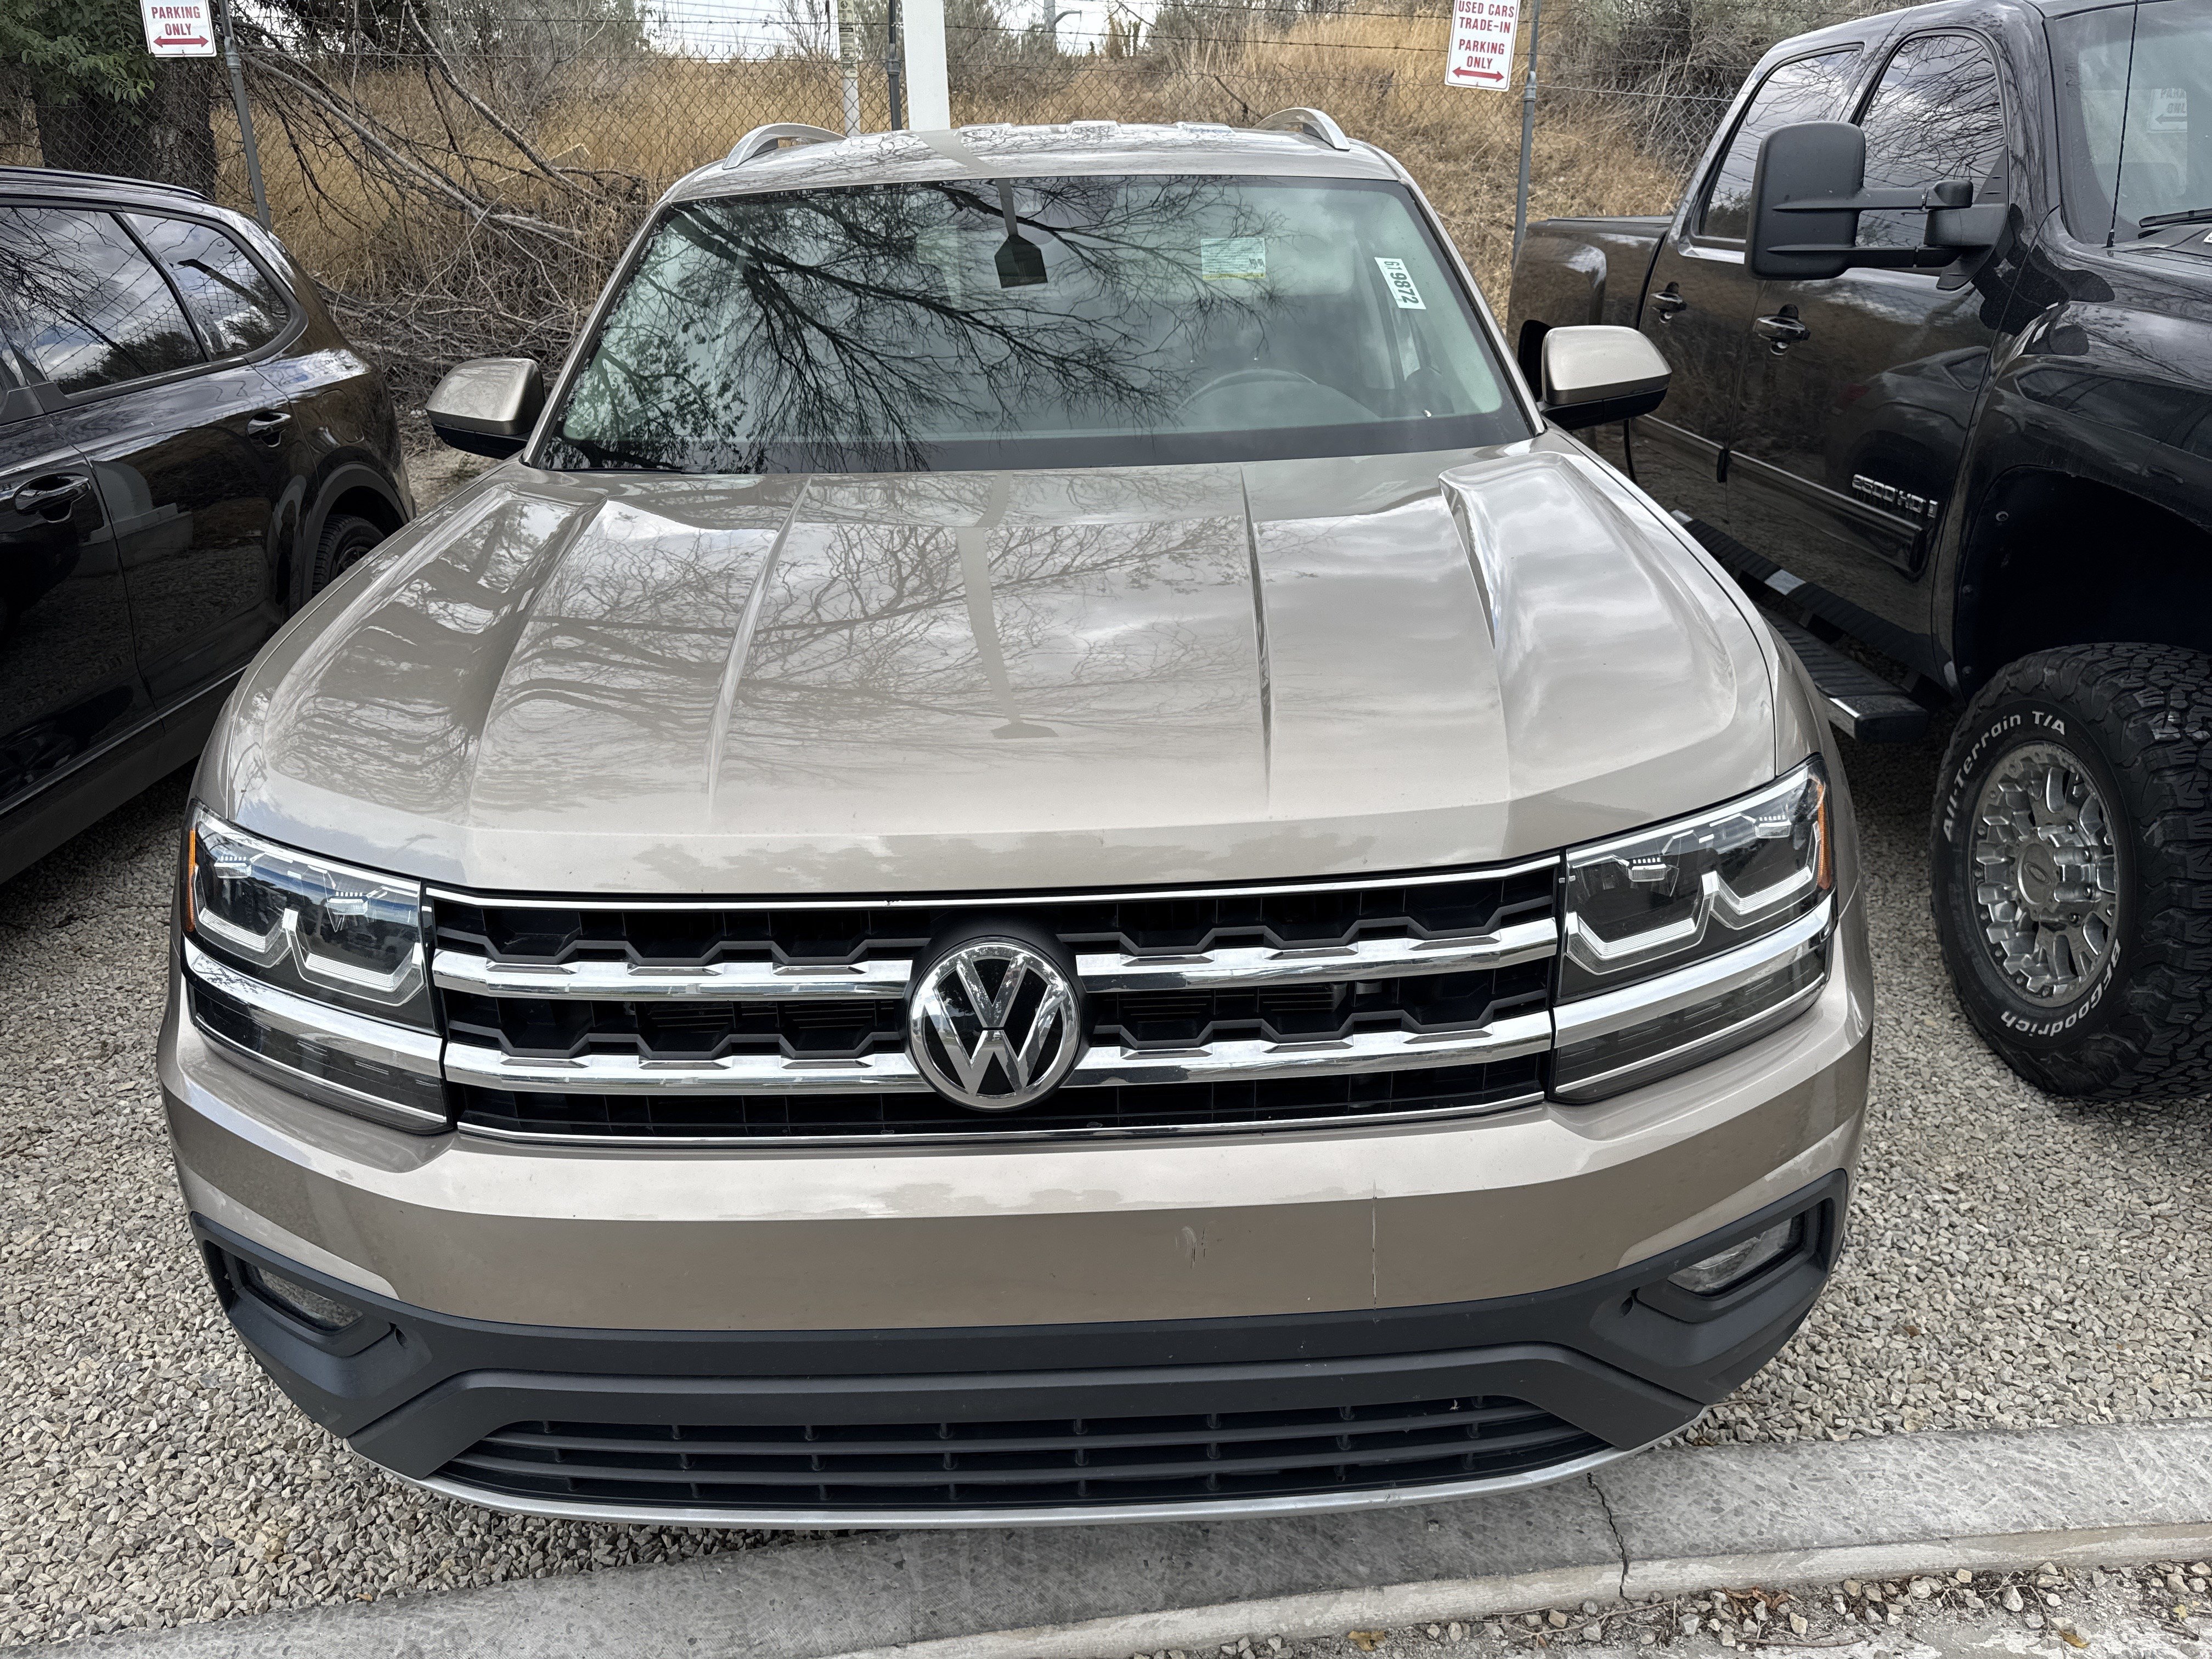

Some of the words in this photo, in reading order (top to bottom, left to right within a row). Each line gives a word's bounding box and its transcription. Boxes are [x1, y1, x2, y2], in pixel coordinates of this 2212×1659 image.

[151, 7, 200, 19] PARKING
[1458, 1, 1484, 14] USED
[1488, 4, 1515, 18] CARS
[165, 24, 192, 36] ONLY
[1459, 17, 1511, 33] TRADE-IN
[1458, 39, 1505, 54] PARKING
[1466, 56, 1493, 69] ONLY
[2032, 710, 2066, 736] T/A
[2001, 939, 2121, 1037] BFGoodrich
